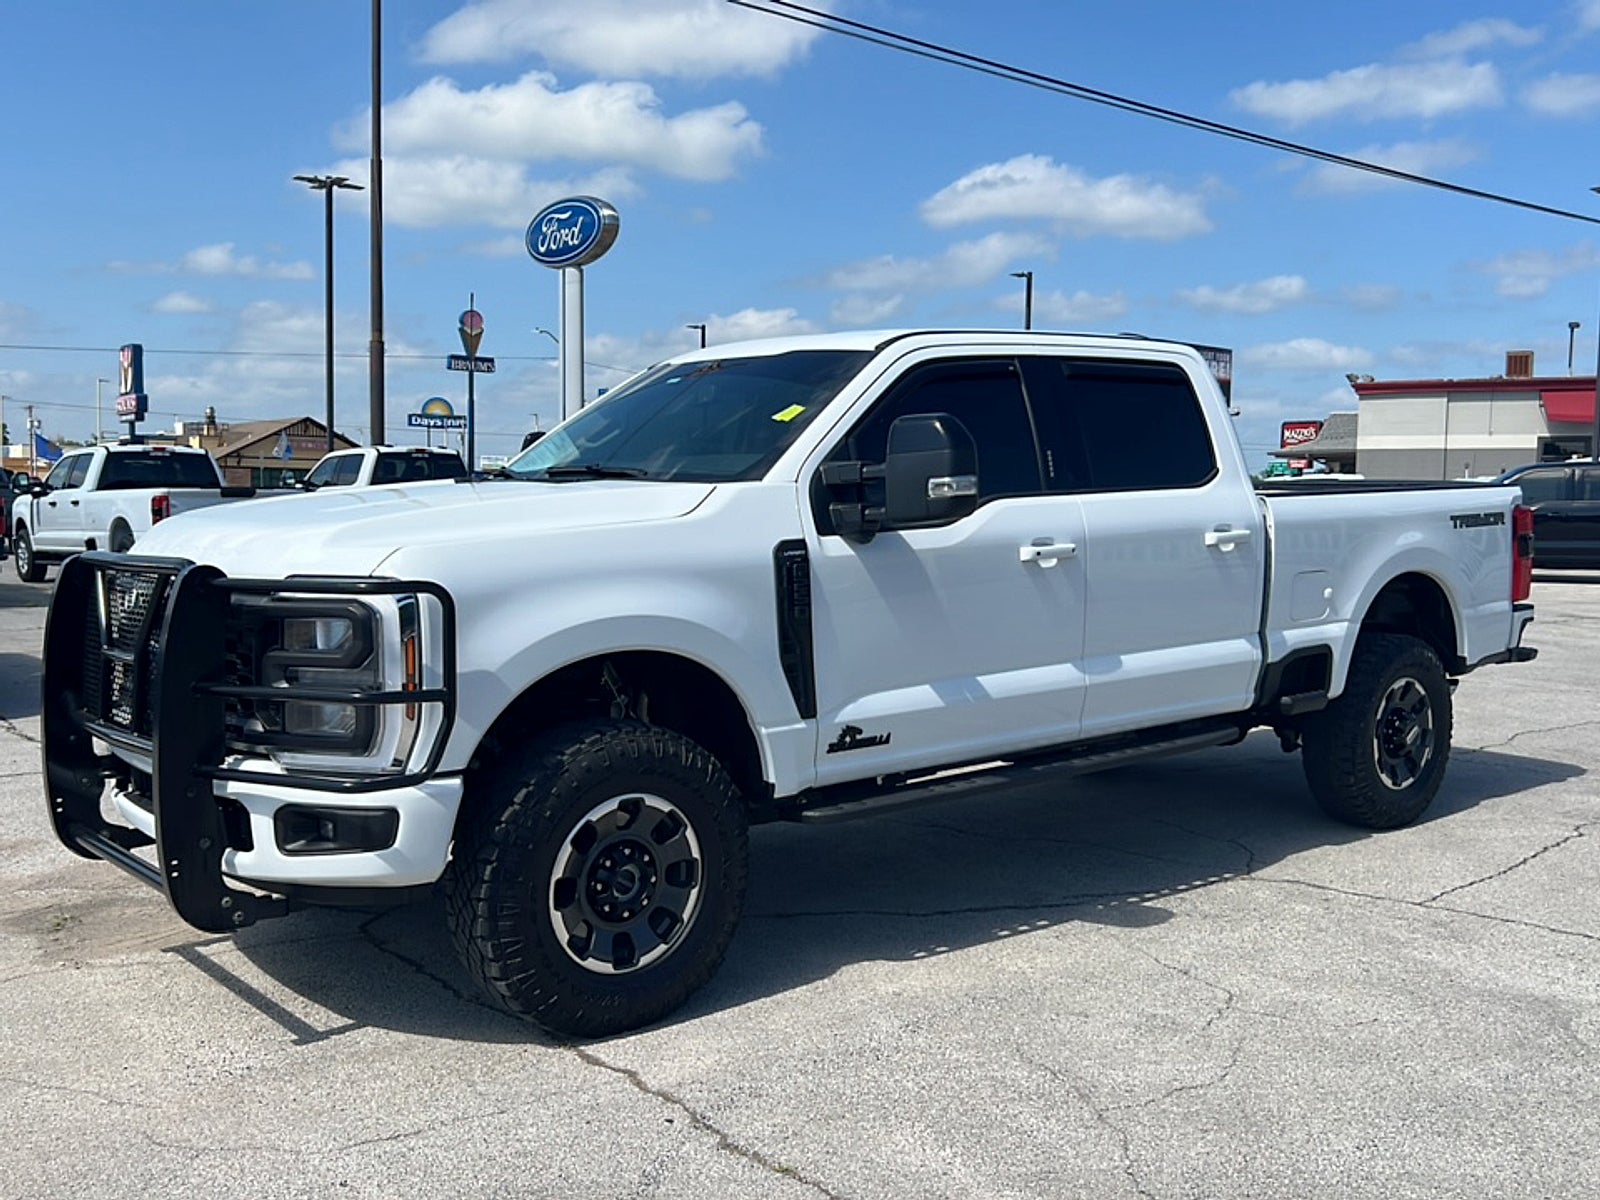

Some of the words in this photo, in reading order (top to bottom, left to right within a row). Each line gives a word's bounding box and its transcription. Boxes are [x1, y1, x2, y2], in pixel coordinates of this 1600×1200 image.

[538, 210, 584, 253] Ford
[411, 416, 442, 427] Days
[1450, 511, 1505, 529] TREMOR
